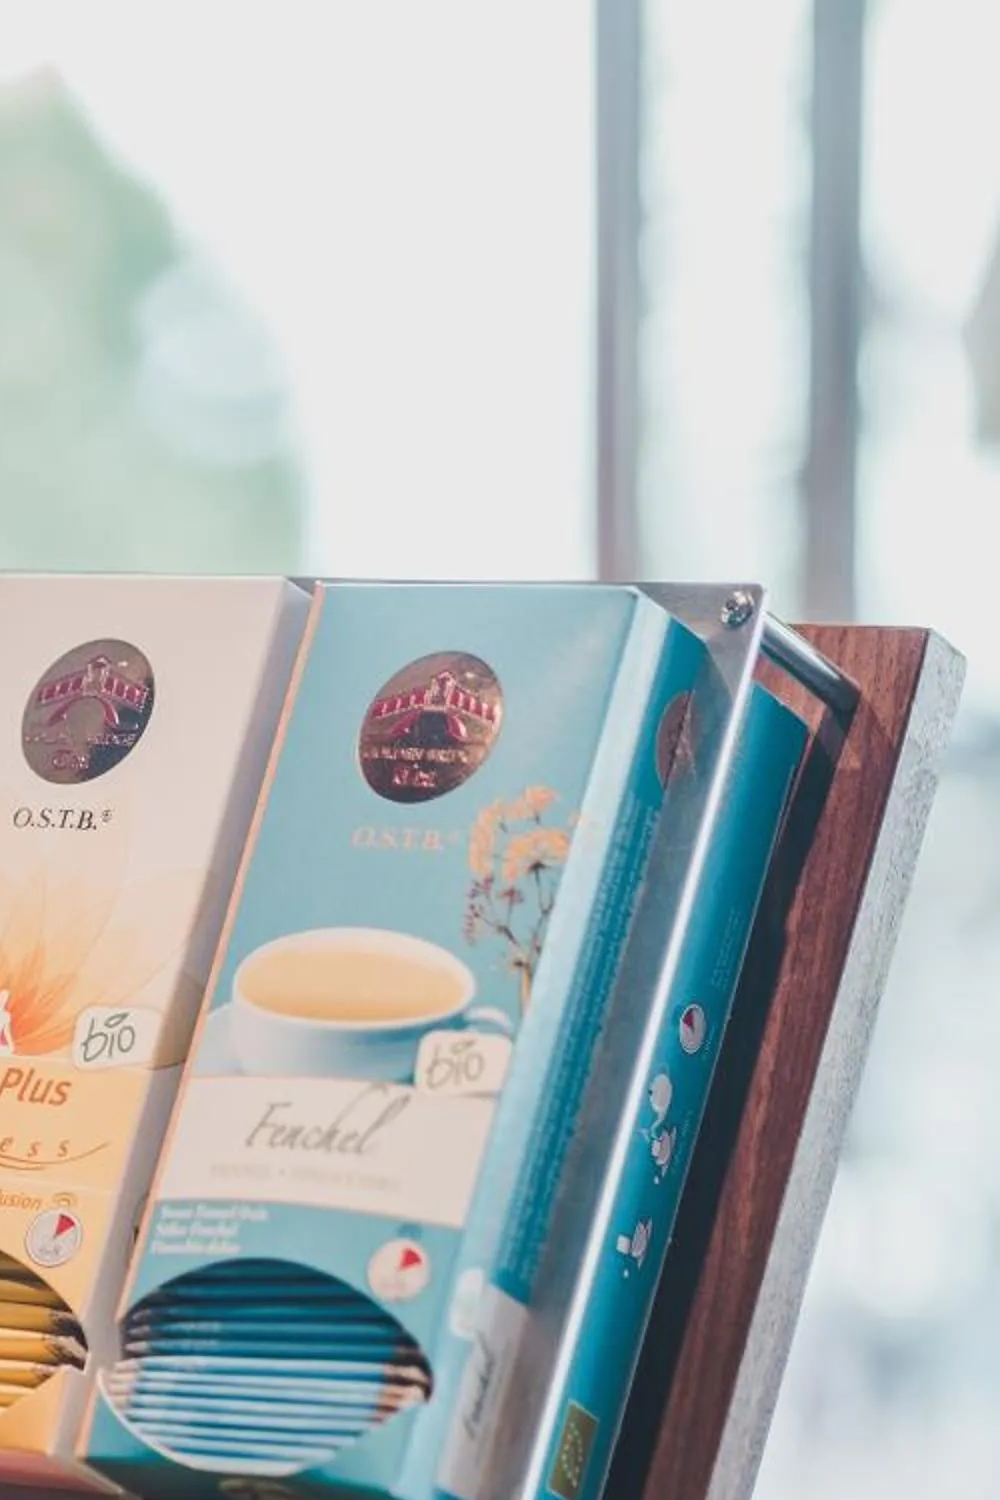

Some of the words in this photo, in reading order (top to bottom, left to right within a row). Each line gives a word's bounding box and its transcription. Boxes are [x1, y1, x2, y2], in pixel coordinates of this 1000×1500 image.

[82, 1012, 136, 1062] bio
[425, 1040, 487, 1090] bio
[244, 1083, 413, 1155] Fenchel
